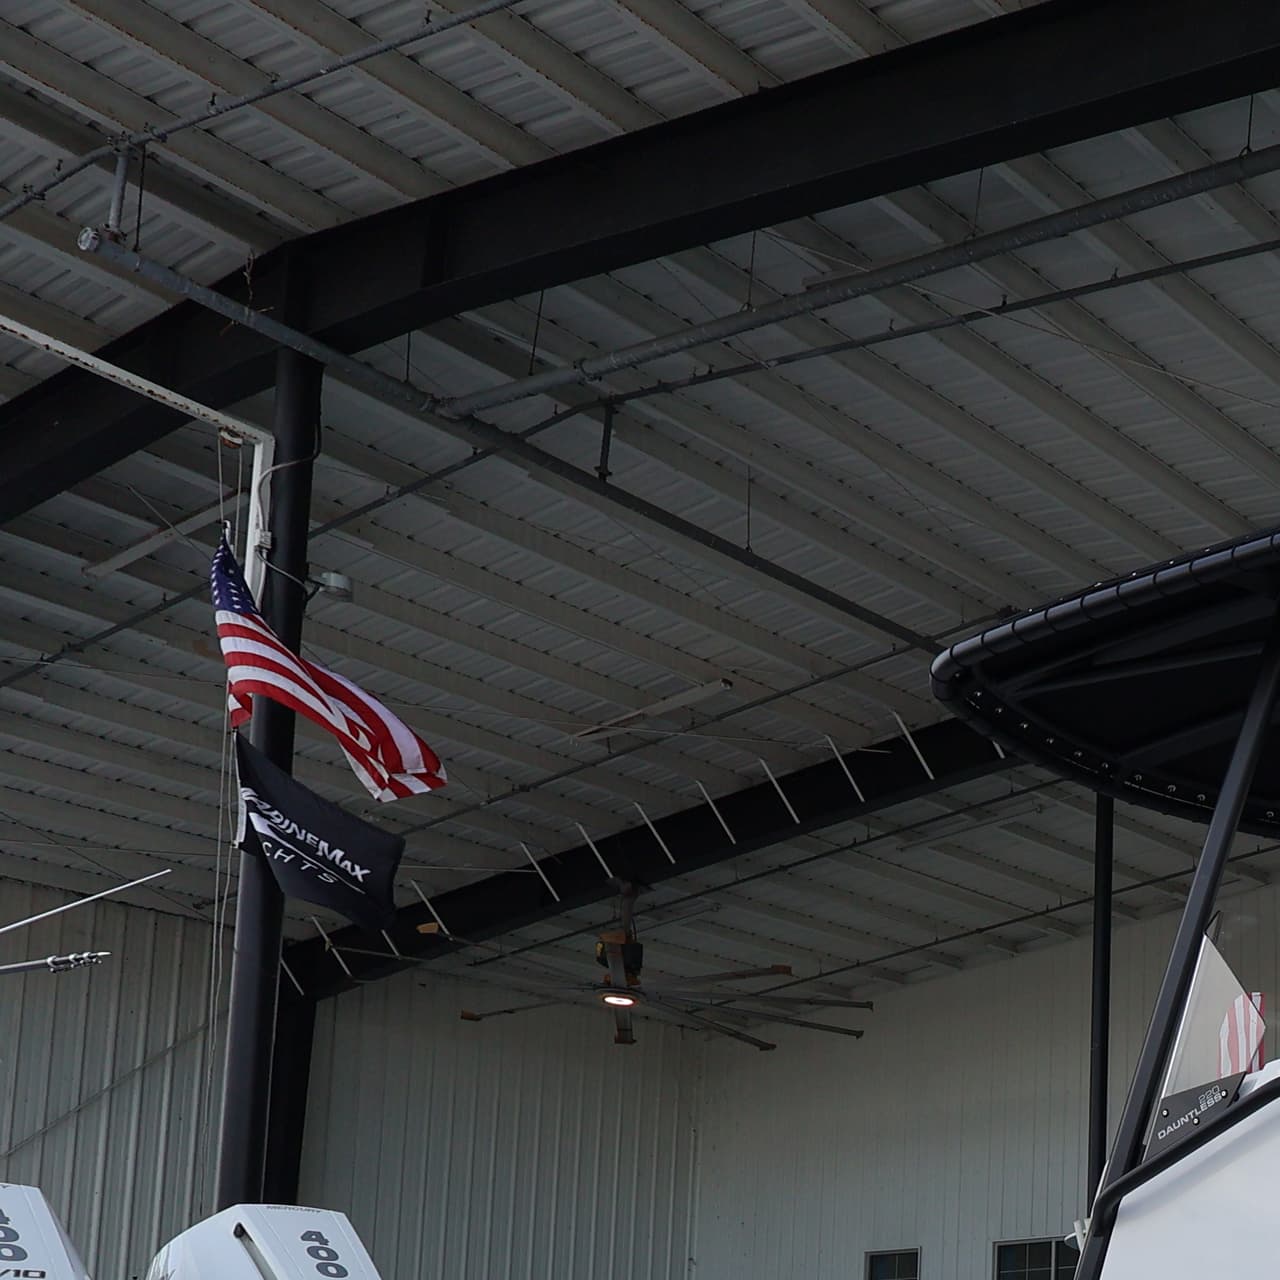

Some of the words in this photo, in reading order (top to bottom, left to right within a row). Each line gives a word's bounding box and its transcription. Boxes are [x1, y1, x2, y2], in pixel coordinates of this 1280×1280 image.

[1157, 1093, 1222, 1140] DAUNTLESS
[1198, 1084, 1221, 1105] 220
[300, 1231, 349, 1278] 400
